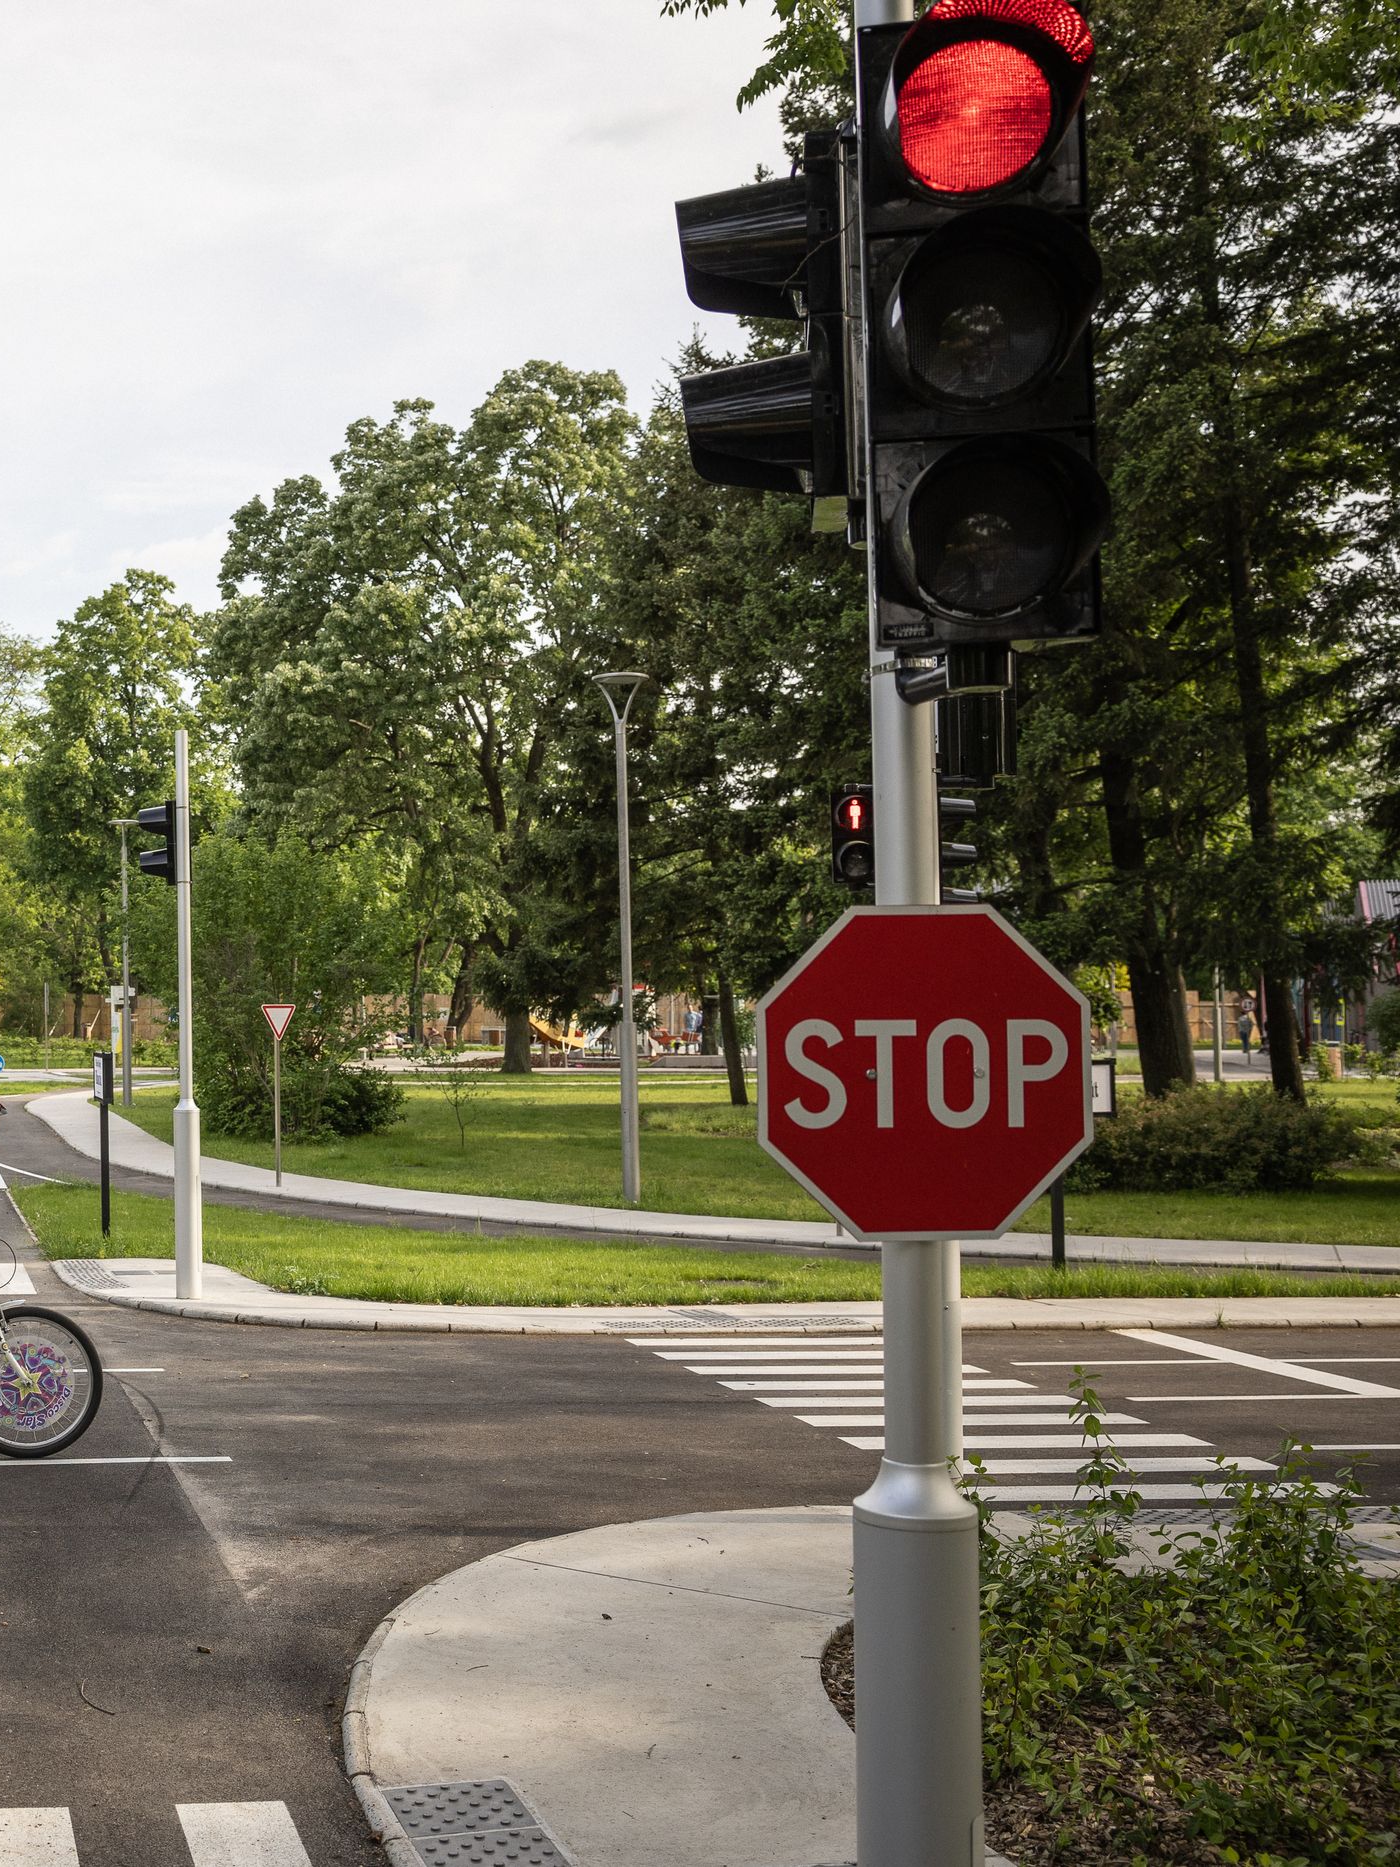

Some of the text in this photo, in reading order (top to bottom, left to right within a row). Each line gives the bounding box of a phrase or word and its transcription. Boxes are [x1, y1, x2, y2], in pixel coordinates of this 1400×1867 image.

[784, 1018, 1068, 1129] STOP
[17, 1386, 71, 1430] Disco Star
